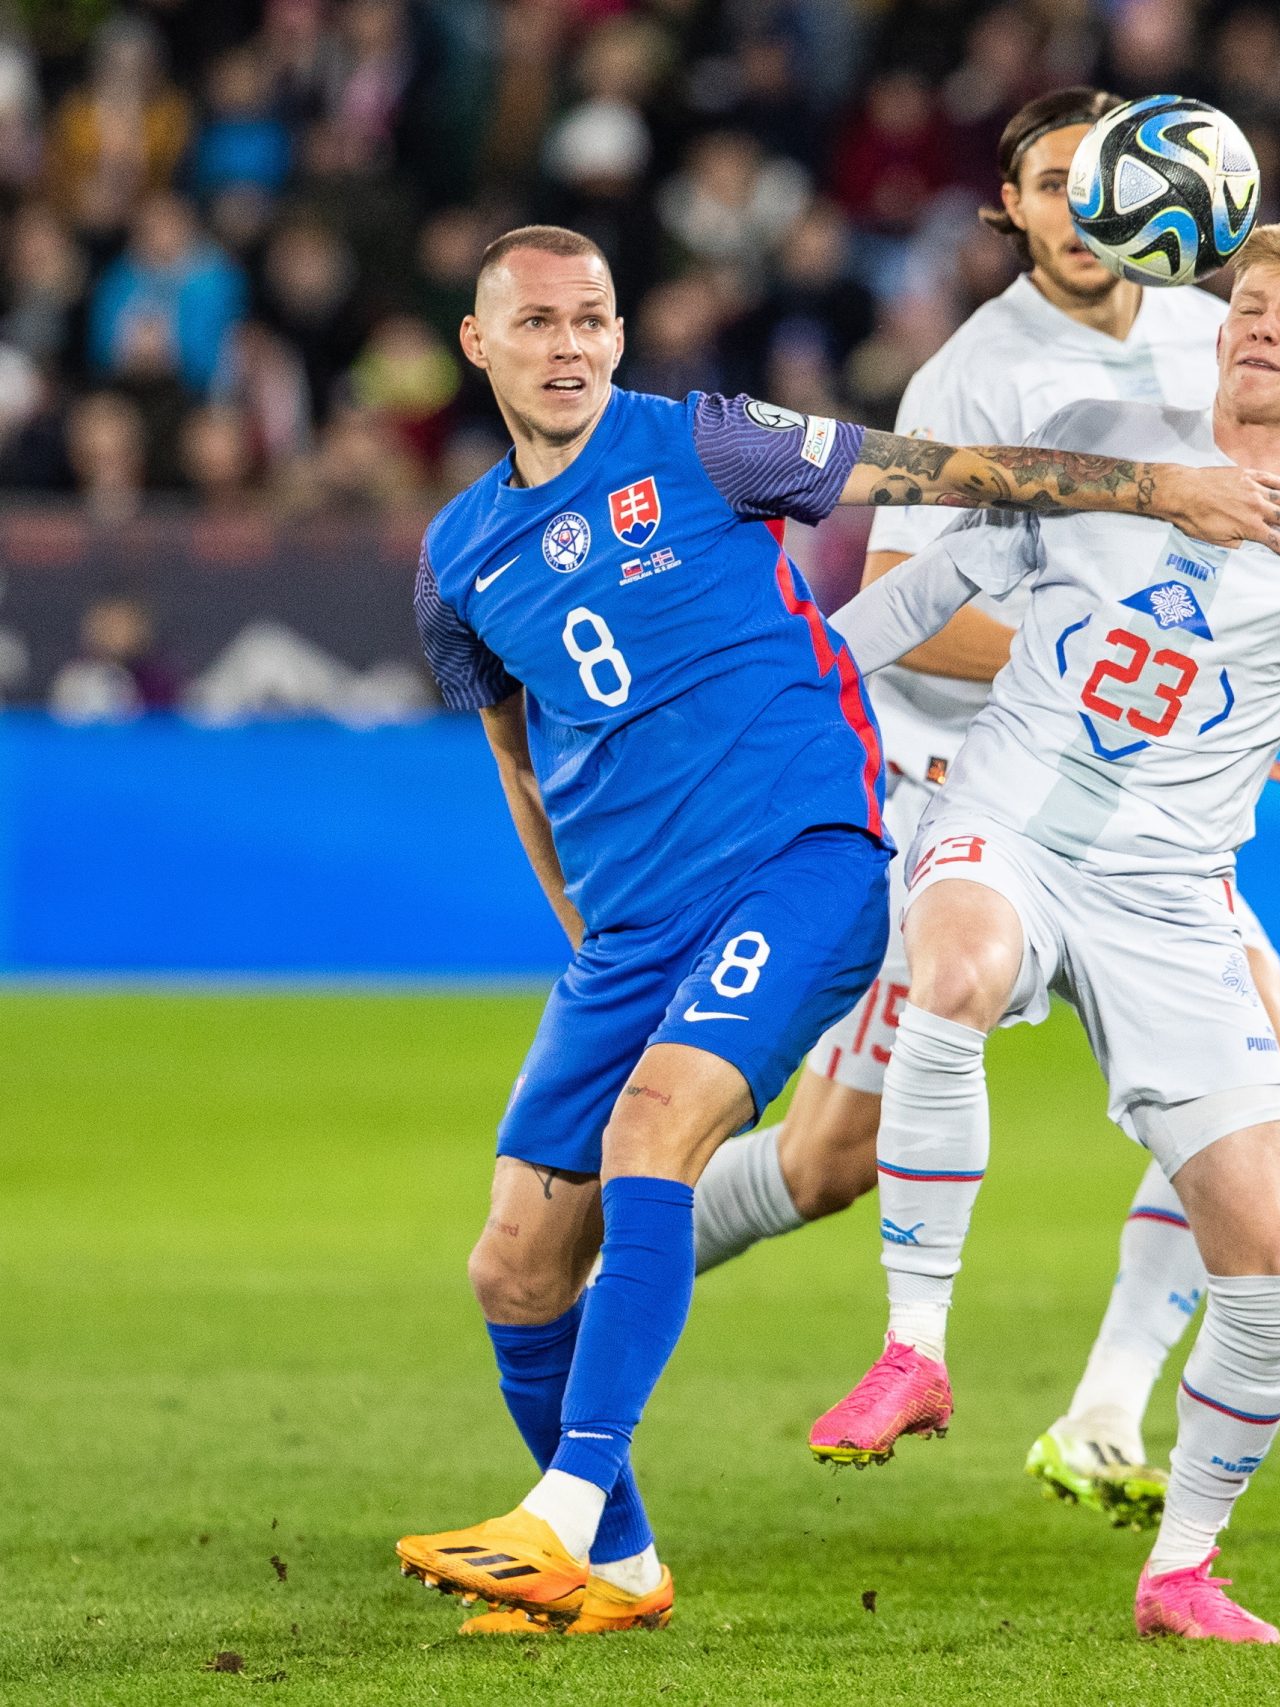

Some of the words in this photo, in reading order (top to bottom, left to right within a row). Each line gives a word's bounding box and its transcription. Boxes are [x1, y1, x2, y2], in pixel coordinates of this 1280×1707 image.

[1166, 552, 1209, 582] PUMA
[561, 605, 633, 708] 8
[1080, 627, 1200, 738] 23
[709, 930, 771, 999] 8
